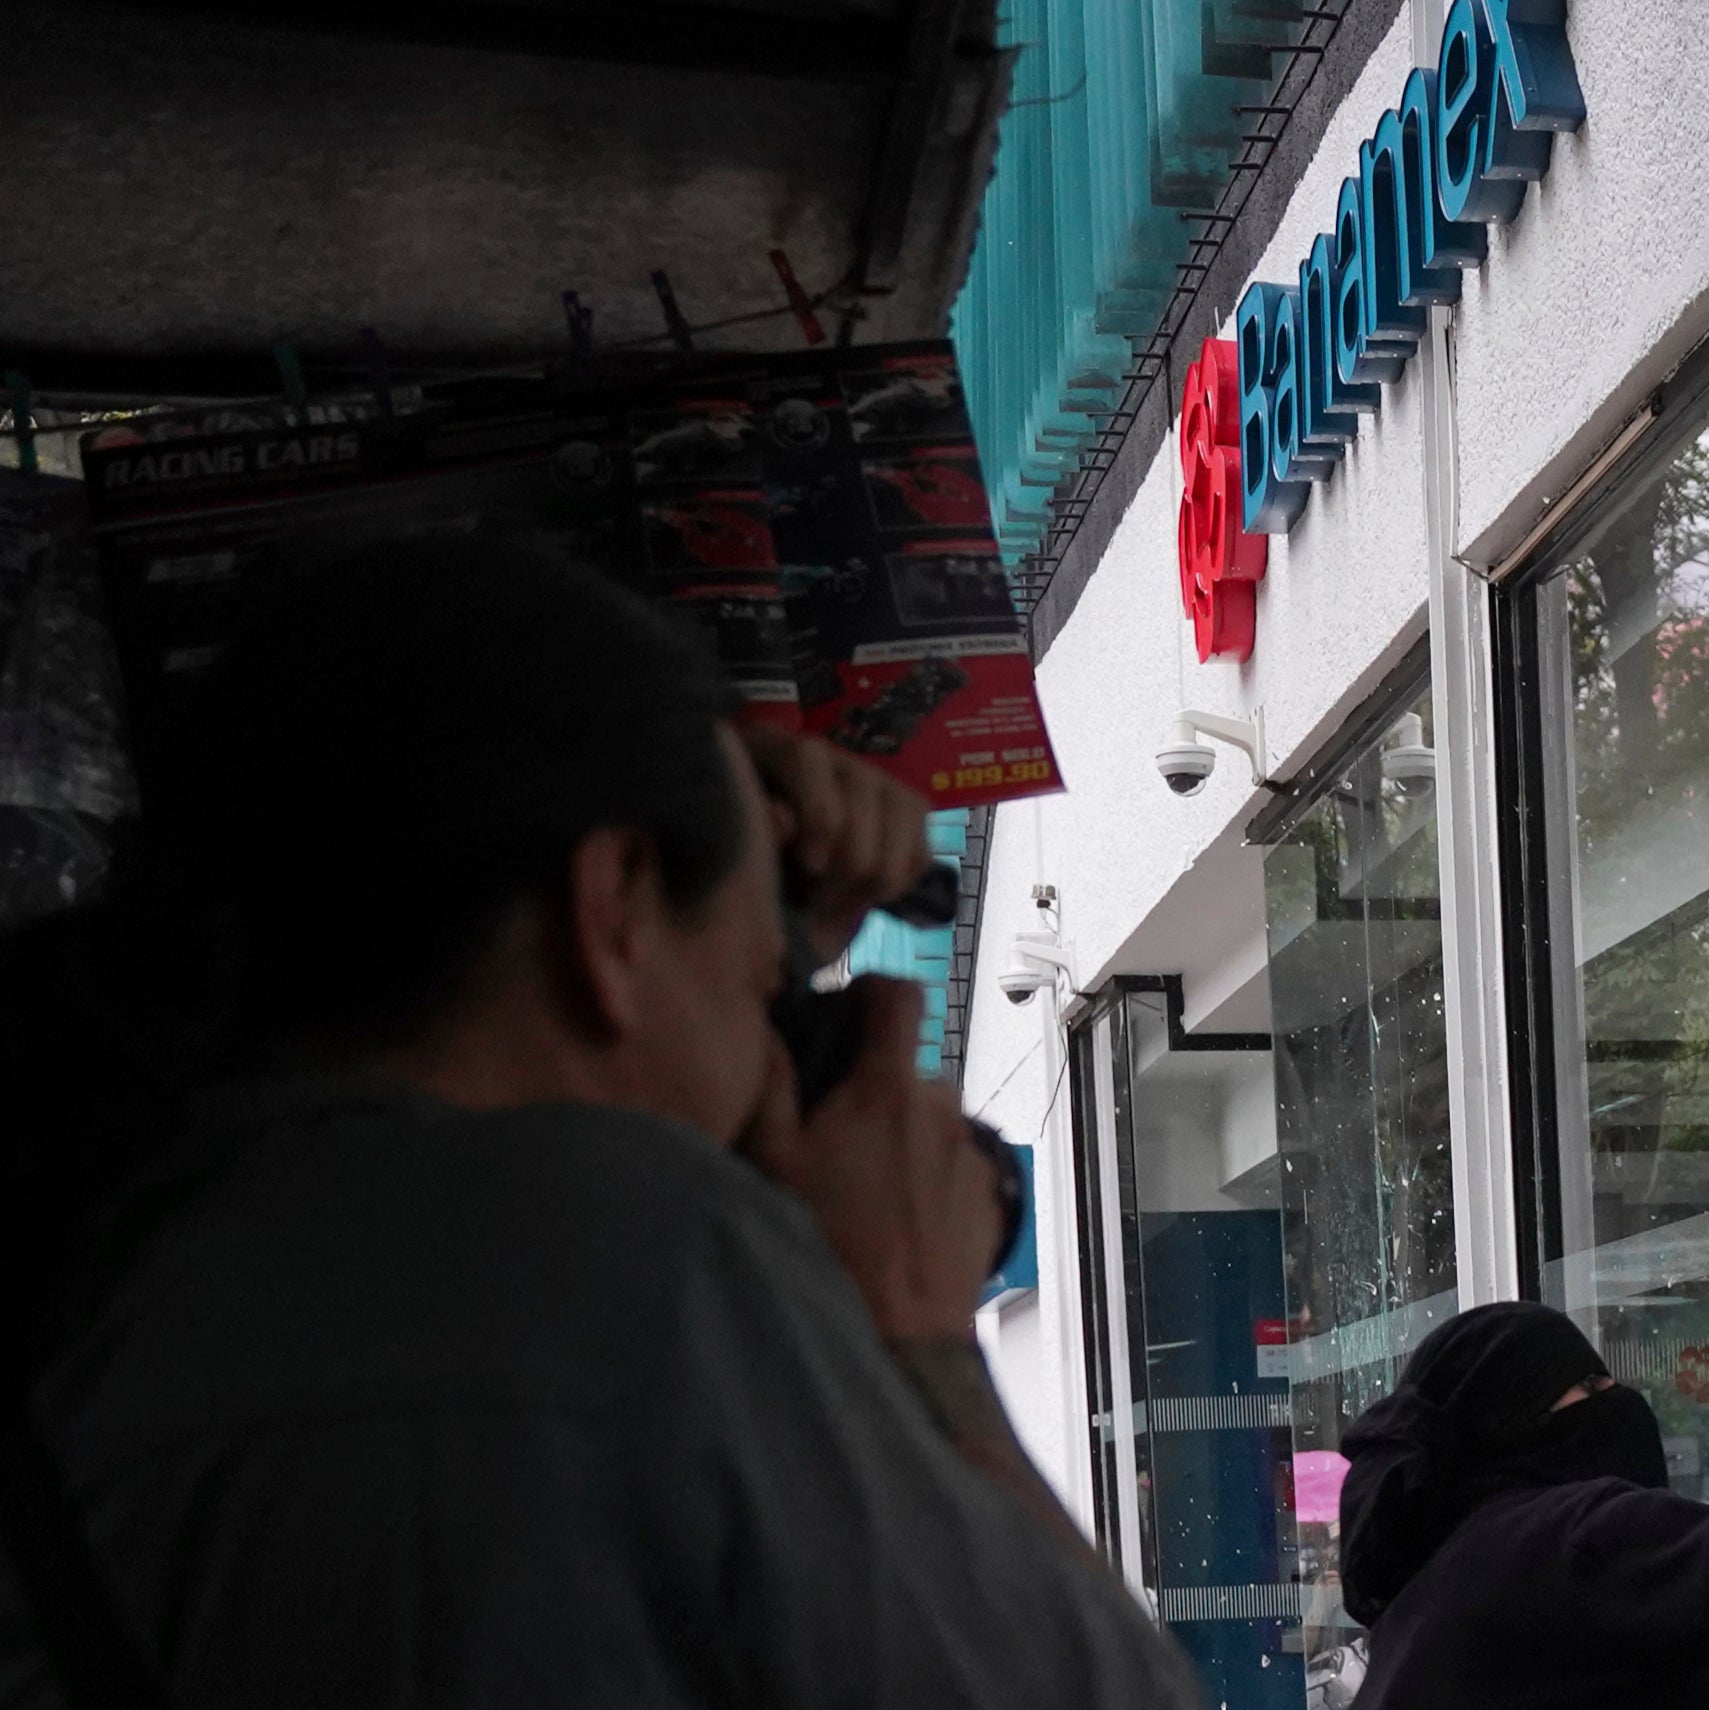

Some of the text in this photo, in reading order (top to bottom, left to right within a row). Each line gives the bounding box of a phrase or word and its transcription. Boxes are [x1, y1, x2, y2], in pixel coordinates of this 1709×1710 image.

[1236, 0, 1545, 533] Banamex
[104, 434, 360, 488] RACING CARS
